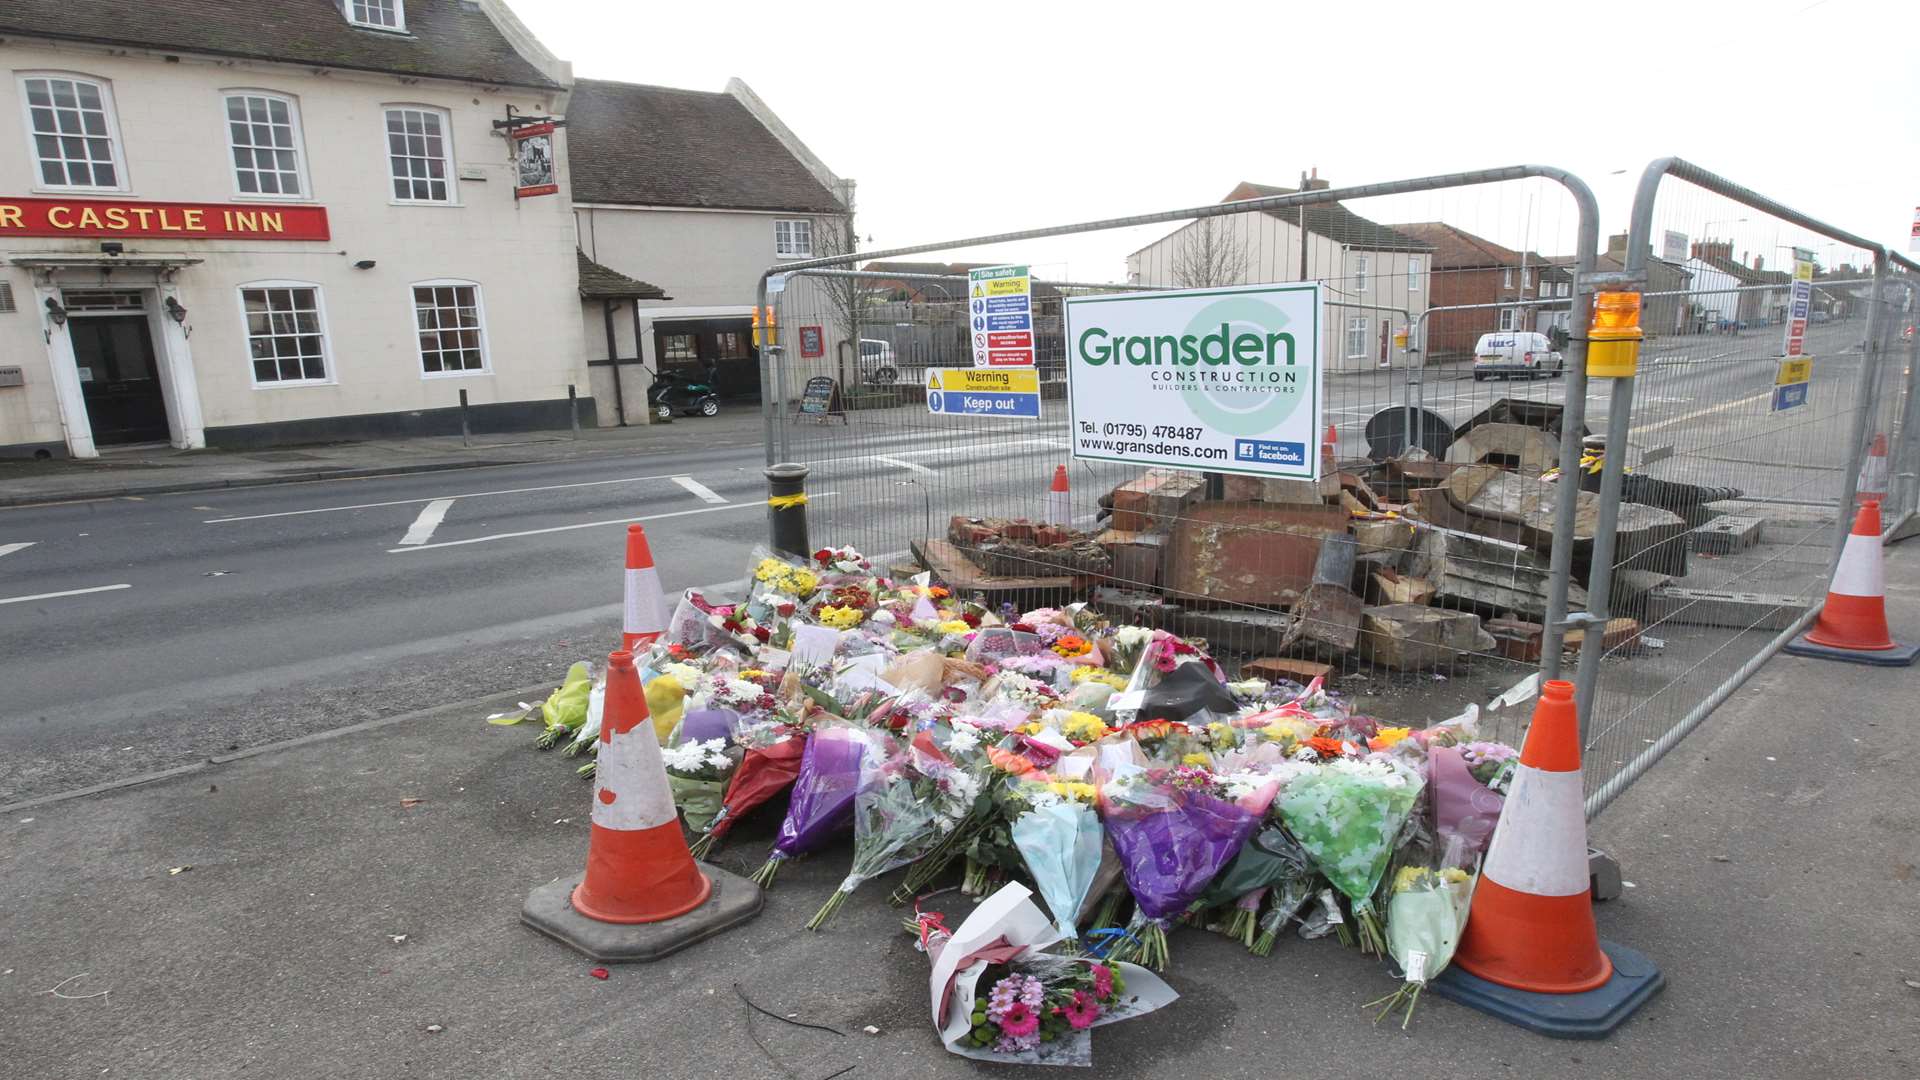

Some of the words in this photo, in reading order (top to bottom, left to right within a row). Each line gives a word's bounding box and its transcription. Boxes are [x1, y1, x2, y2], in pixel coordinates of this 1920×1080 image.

[48, 206, 207, 232] CASTLE
[223, 211, 284, 233] INN
[992, 280, 1020, 289] Warning
[1079, 323, 1296, 366] Gransden
[965, 371, 1009, 384] Warning
[1151, 371, 1296, 383] CONSTRUCTION
[1216, 385, 1295, 393] CONTRACTORS
[964, 396, 992, 411] Keep
[995, 398, 1015, 409] out
[1080, 422, 1098, 434] Tel.
[1103, 423, 1147, 440] (01795)
[1152, 426, 1203, 440] 478487
[1080, 440, 1228, 460] www.gransdens.com
